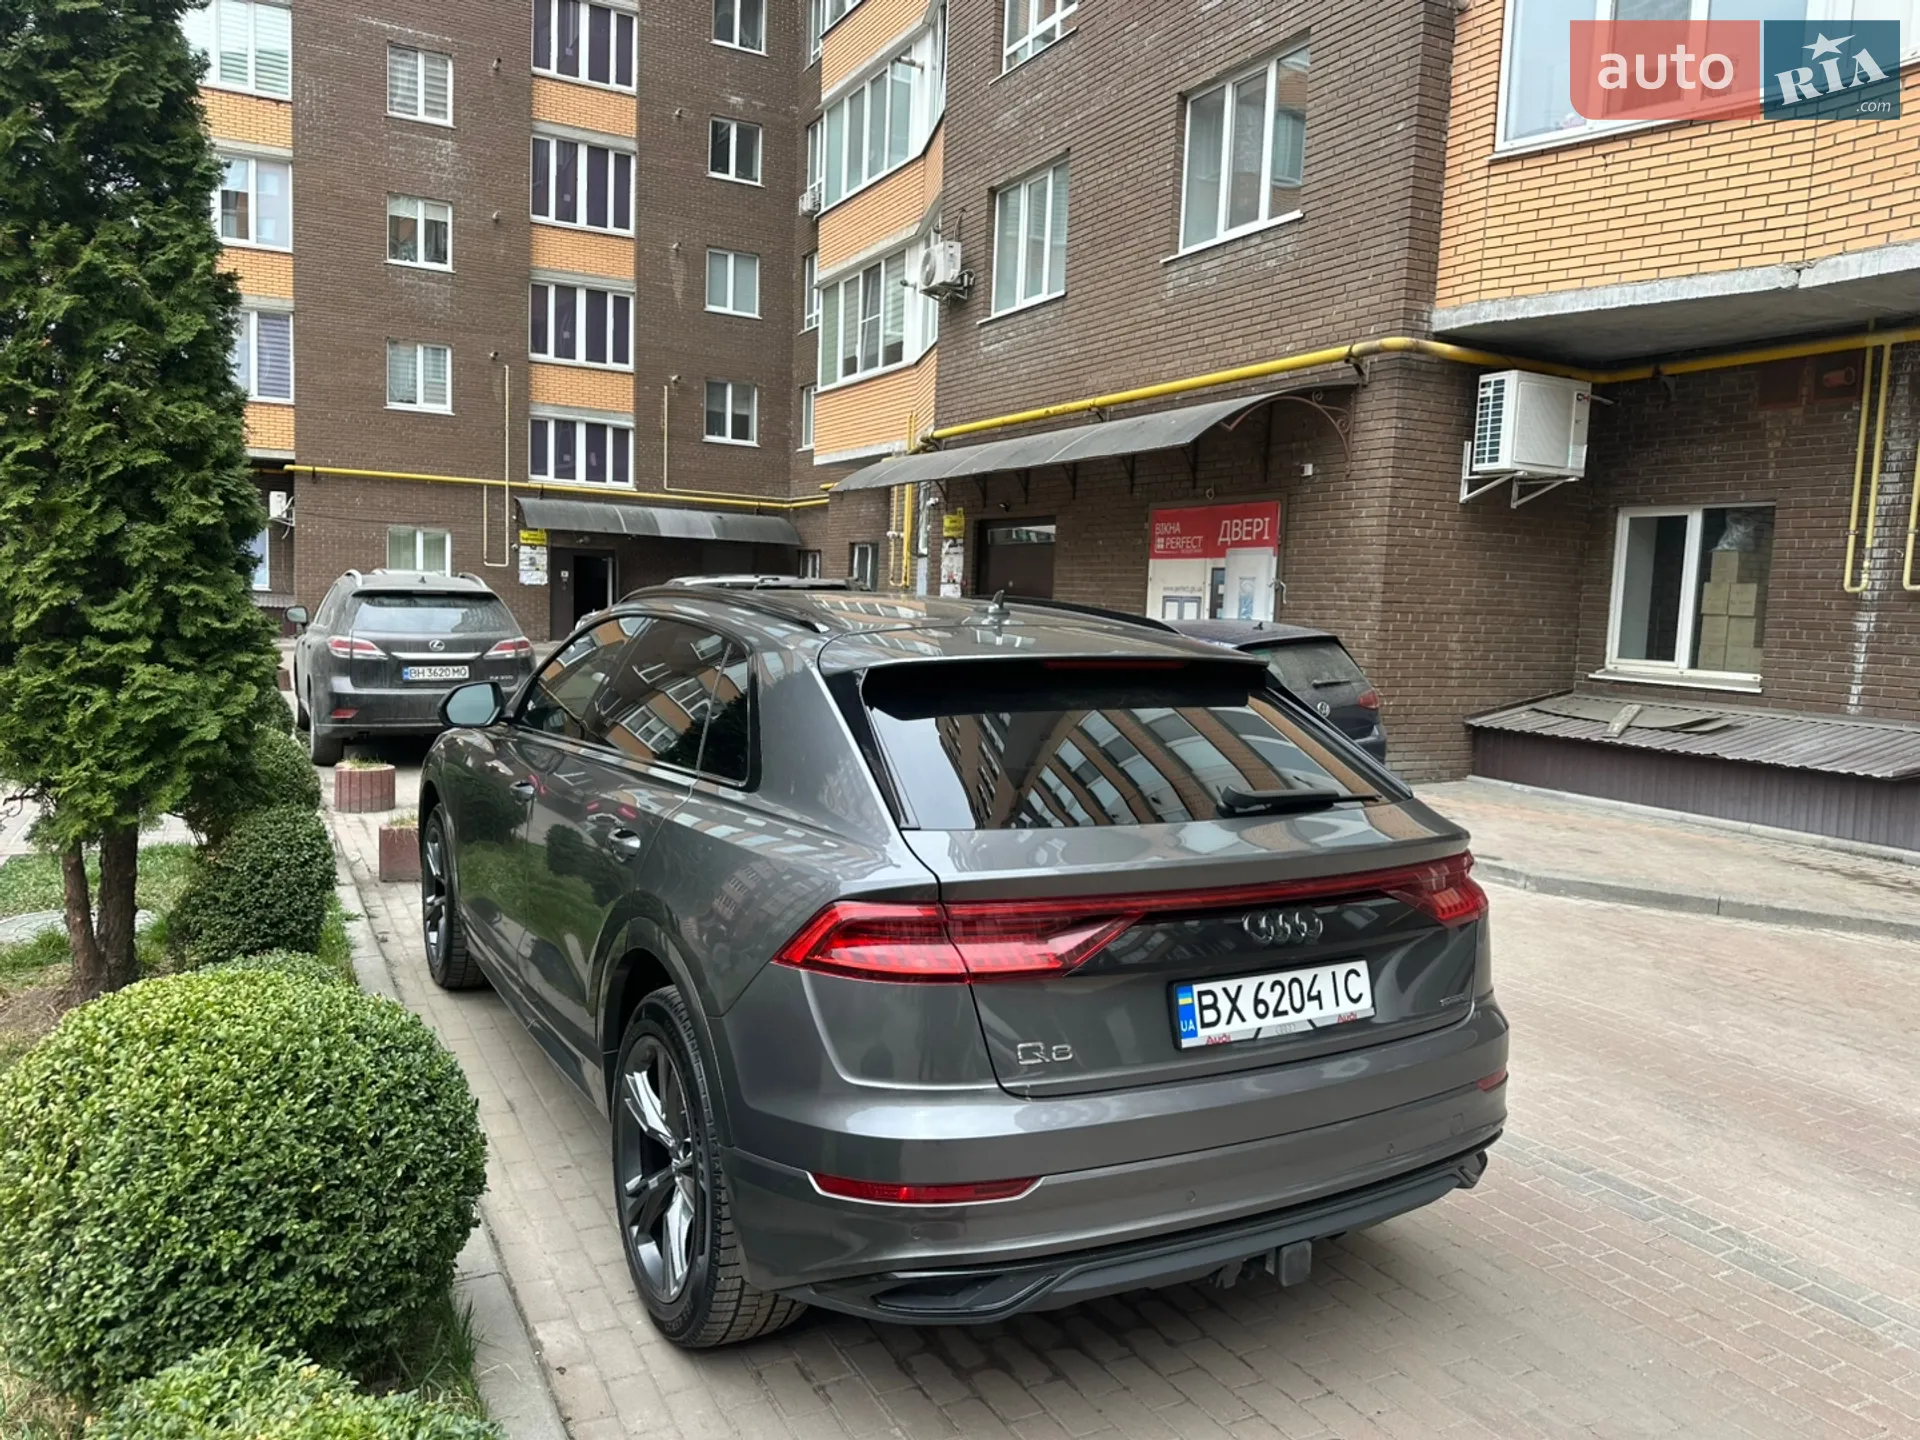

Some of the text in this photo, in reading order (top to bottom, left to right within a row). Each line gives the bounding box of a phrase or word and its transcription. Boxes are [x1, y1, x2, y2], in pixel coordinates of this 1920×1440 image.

[1154, 522, 1181, 535] ВІКНА
[1217, 517, 1271, 546] ДВЕРІ
[1165, 535, 1204, 549] PERFECT
[409, 667, 425, 679] BH
[1197, 968, 1364, 1029] BX 6204 IC
[1336, 1011, 1358, 1024] Audi
[1180, 1018, 1196, 1033] UA
[1206, 1032, 1232, 1046] Audi
[1017, 1041, 1073, 1066] Q8
